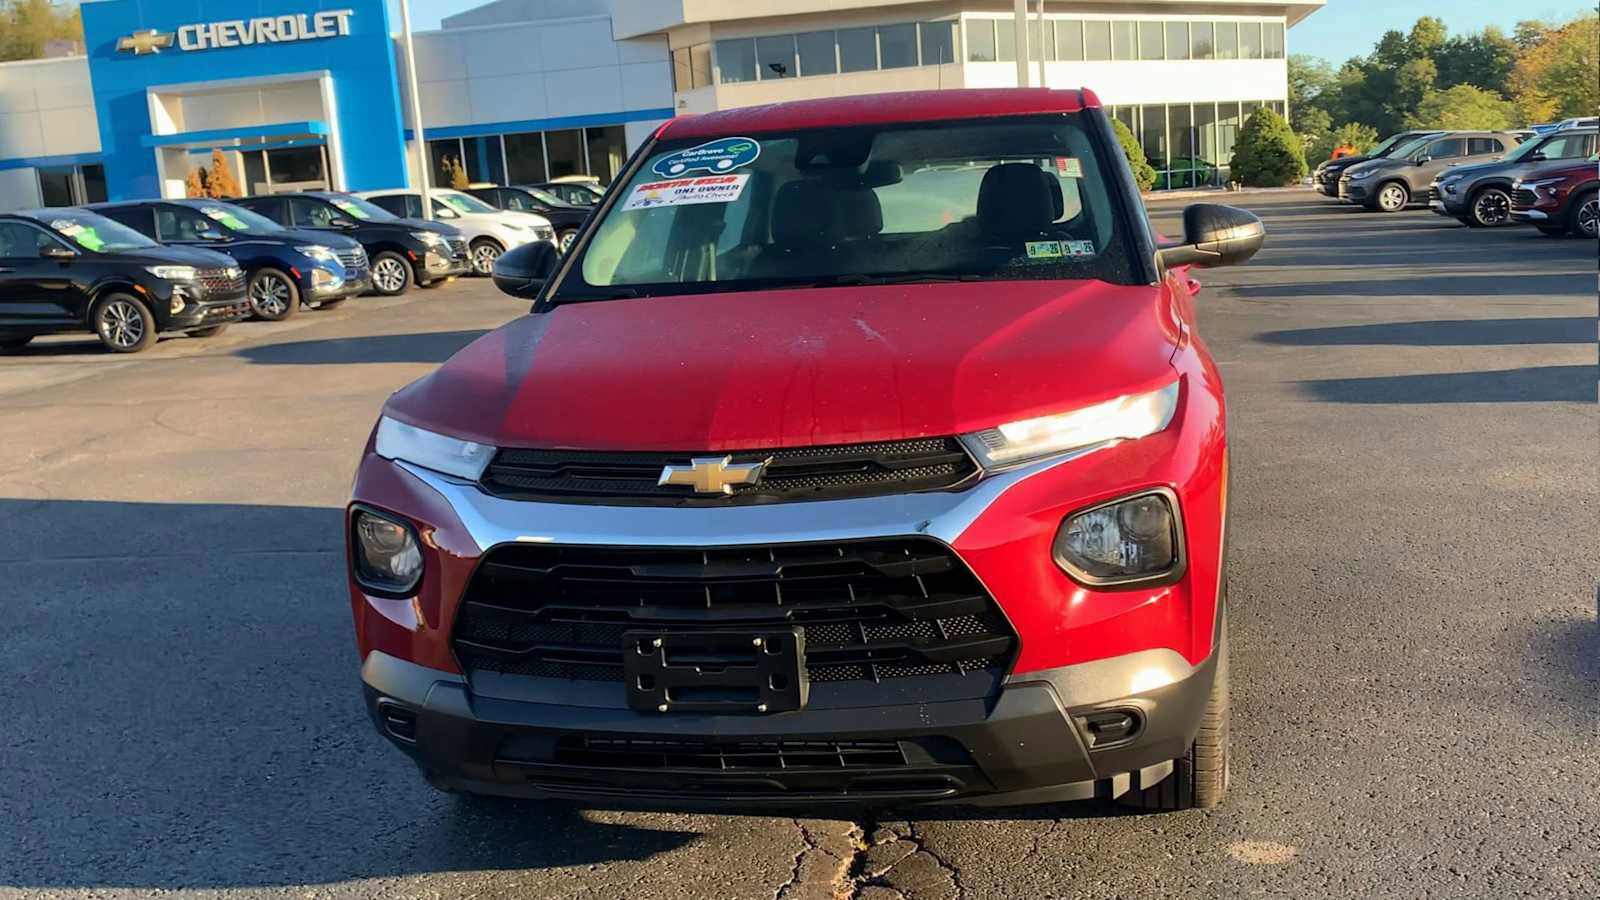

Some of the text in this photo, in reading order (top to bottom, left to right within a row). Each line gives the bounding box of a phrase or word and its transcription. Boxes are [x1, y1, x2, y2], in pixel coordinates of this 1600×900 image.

[177, 9, 353, 51] CHEVROLET
[674, 184, 740, 195] ONE OWNER
